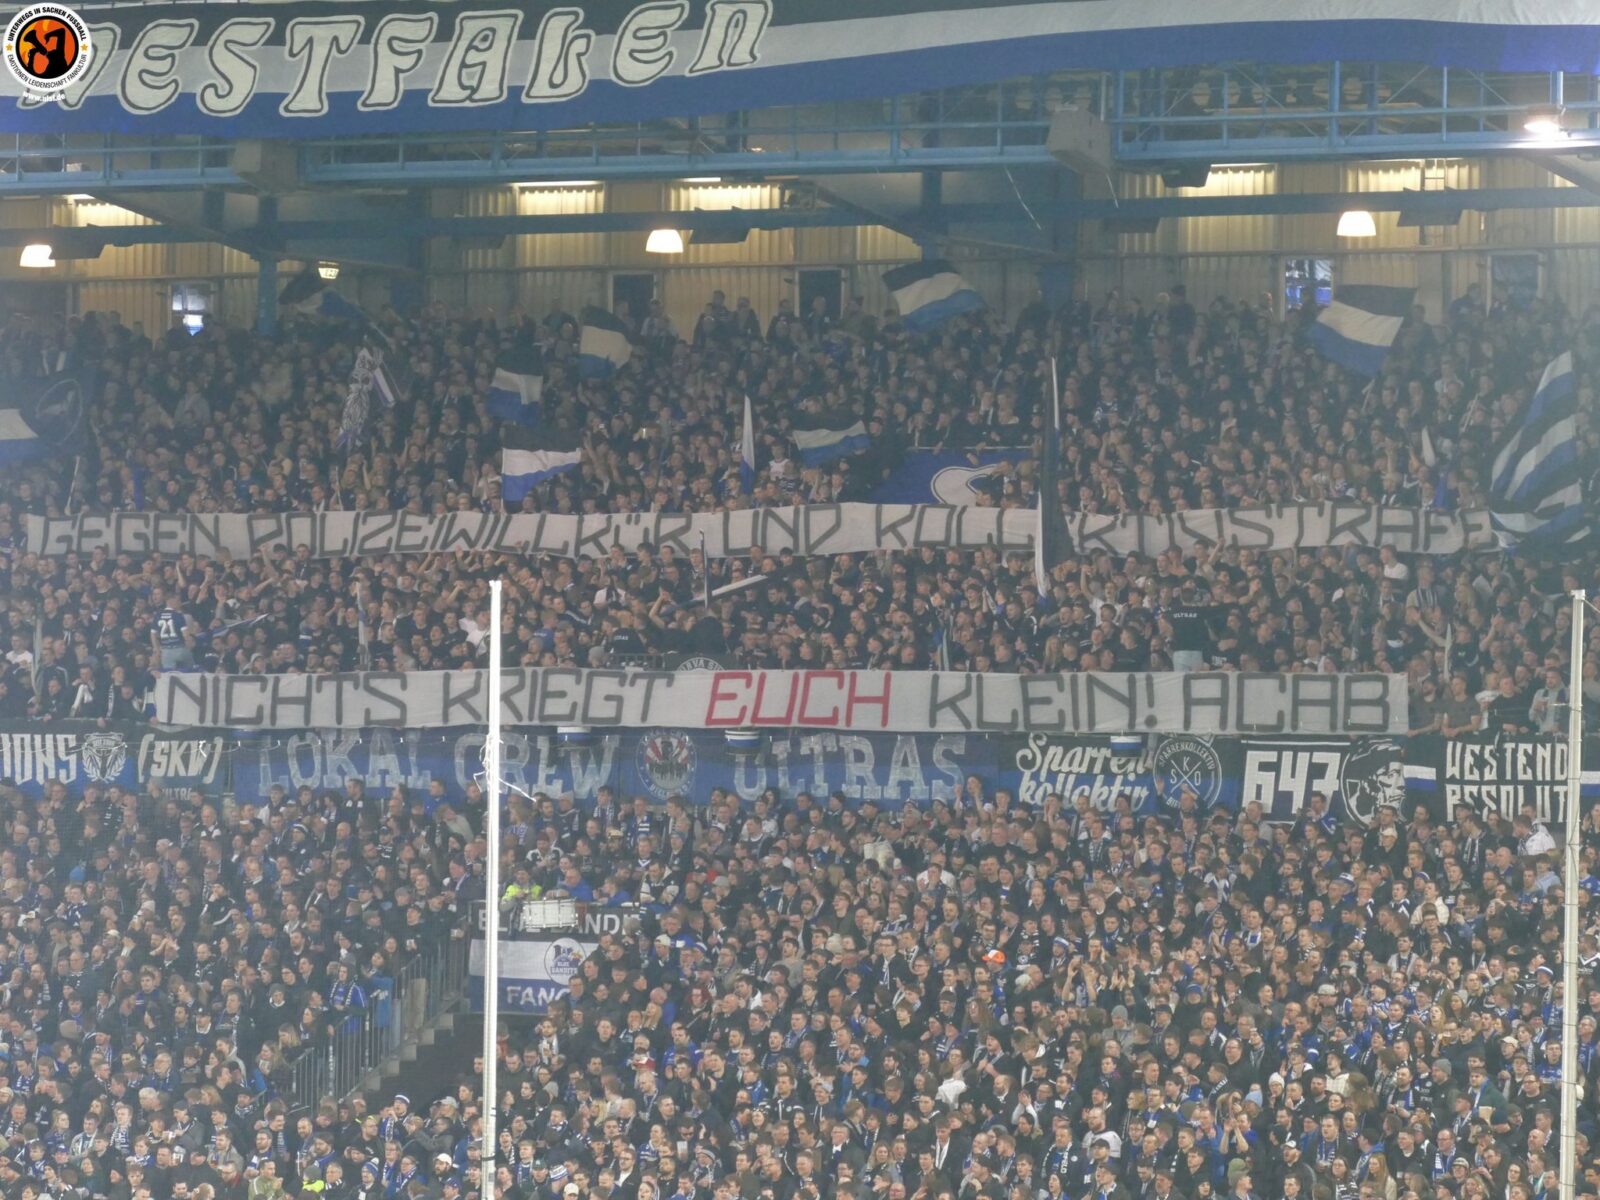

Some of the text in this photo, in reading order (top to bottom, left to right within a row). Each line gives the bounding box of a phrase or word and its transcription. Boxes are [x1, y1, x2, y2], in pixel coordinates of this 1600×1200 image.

[40, 511, 222, 562] GEGEN
[721, 505, 841, 555] UND
[157, 619, 178, 638] 21
[167, 668, 1389, 732] NICHTS KRIEGT EUCH KLEIN! ACAB
[258, 727, 620, 800] LOKAL CREW
[734, 732, 967, 801] ULTRAS
[1242, 750, 1342, 815] 647
[1446, 741, 1569, 782] WESTEND
